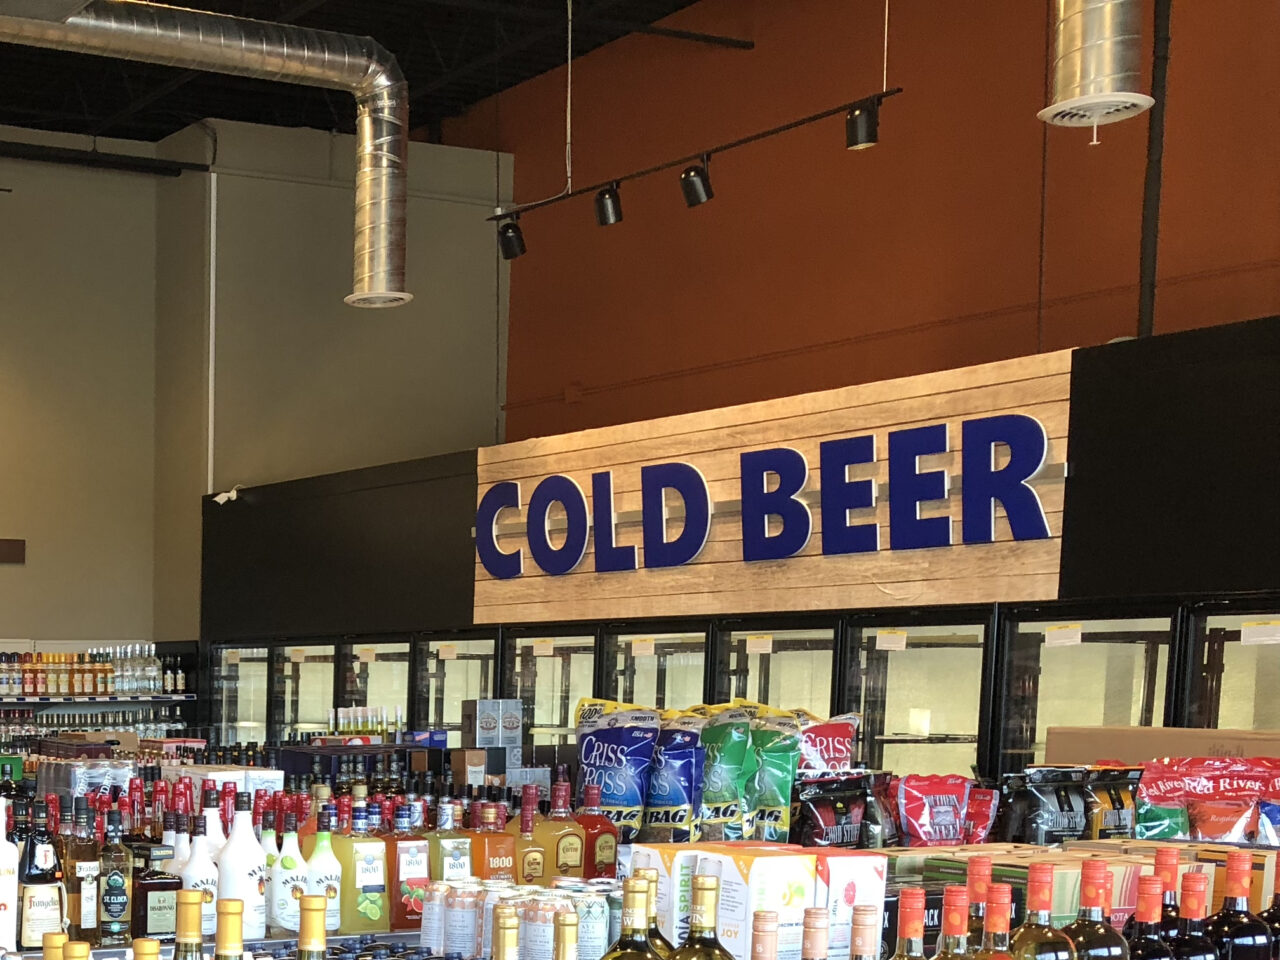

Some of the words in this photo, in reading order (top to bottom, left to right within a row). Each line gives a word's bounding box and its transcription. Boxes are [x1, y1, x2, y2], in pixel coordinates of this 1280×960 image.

[475, 460, 712, 580] COLD
[740, 413, 1052, 562] BEER
[581, 735, 628, 769] CRISS
[1219, 777, 1266, 792] River
[489, 856, 513, 868] 1800
[679, 863, 691, 914] SPIRIT
[721, 929, 739, 939] JOY
